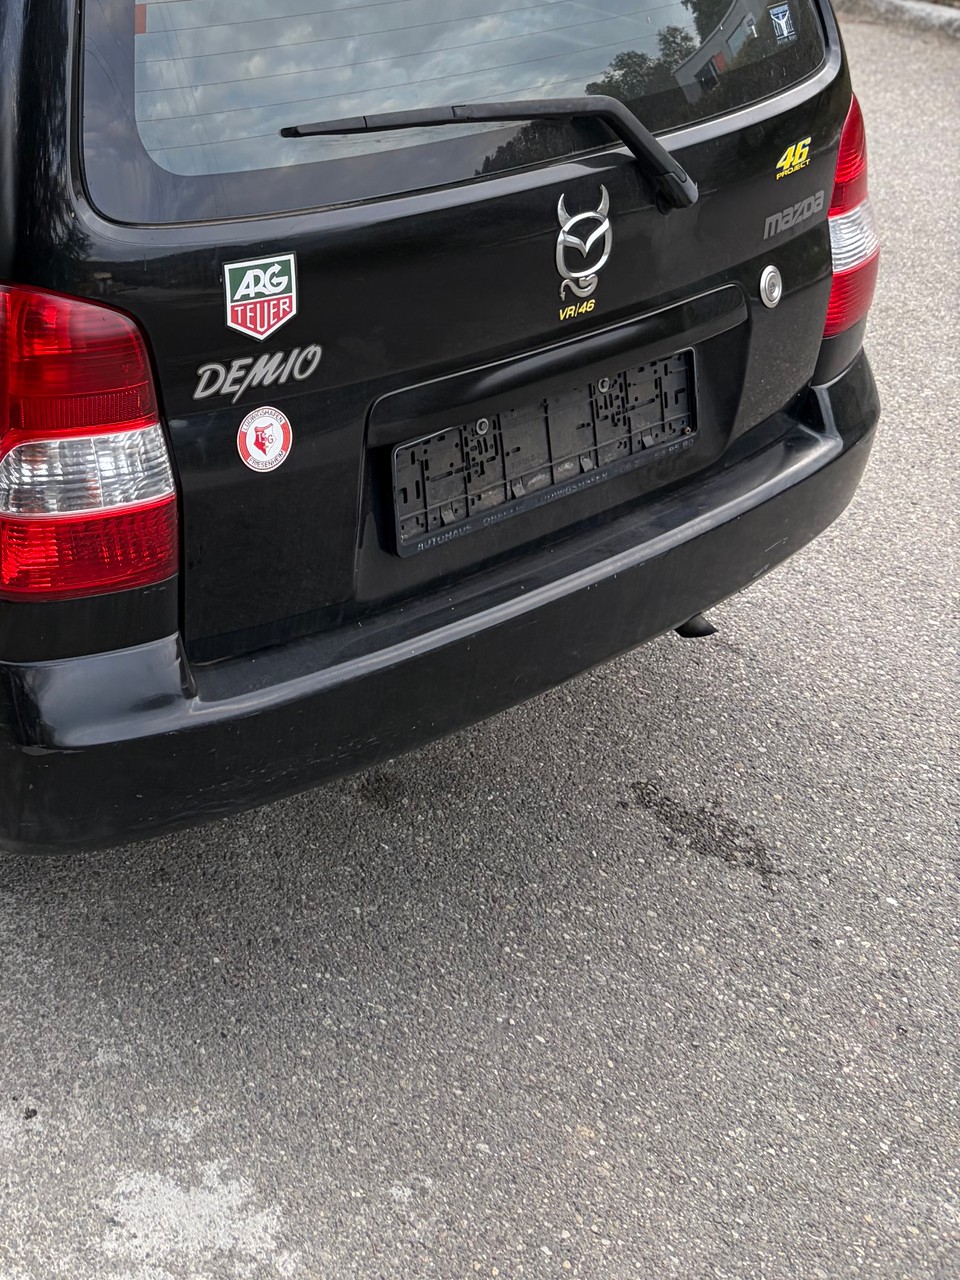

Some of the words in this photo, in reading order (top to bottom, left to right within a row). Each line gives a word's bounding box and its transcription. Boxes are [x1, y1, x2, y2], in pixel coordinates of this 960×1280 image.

[776, 137, 812, 171] 46
[776, 158, 812, 181] PROJECT
[234, 298, 291, 332] TEUER
[192, 343, 323, 404] DEMIO
[256, 431, 274, 444] TSG
[249, 451, 284, 468] FRIESENHEIM
